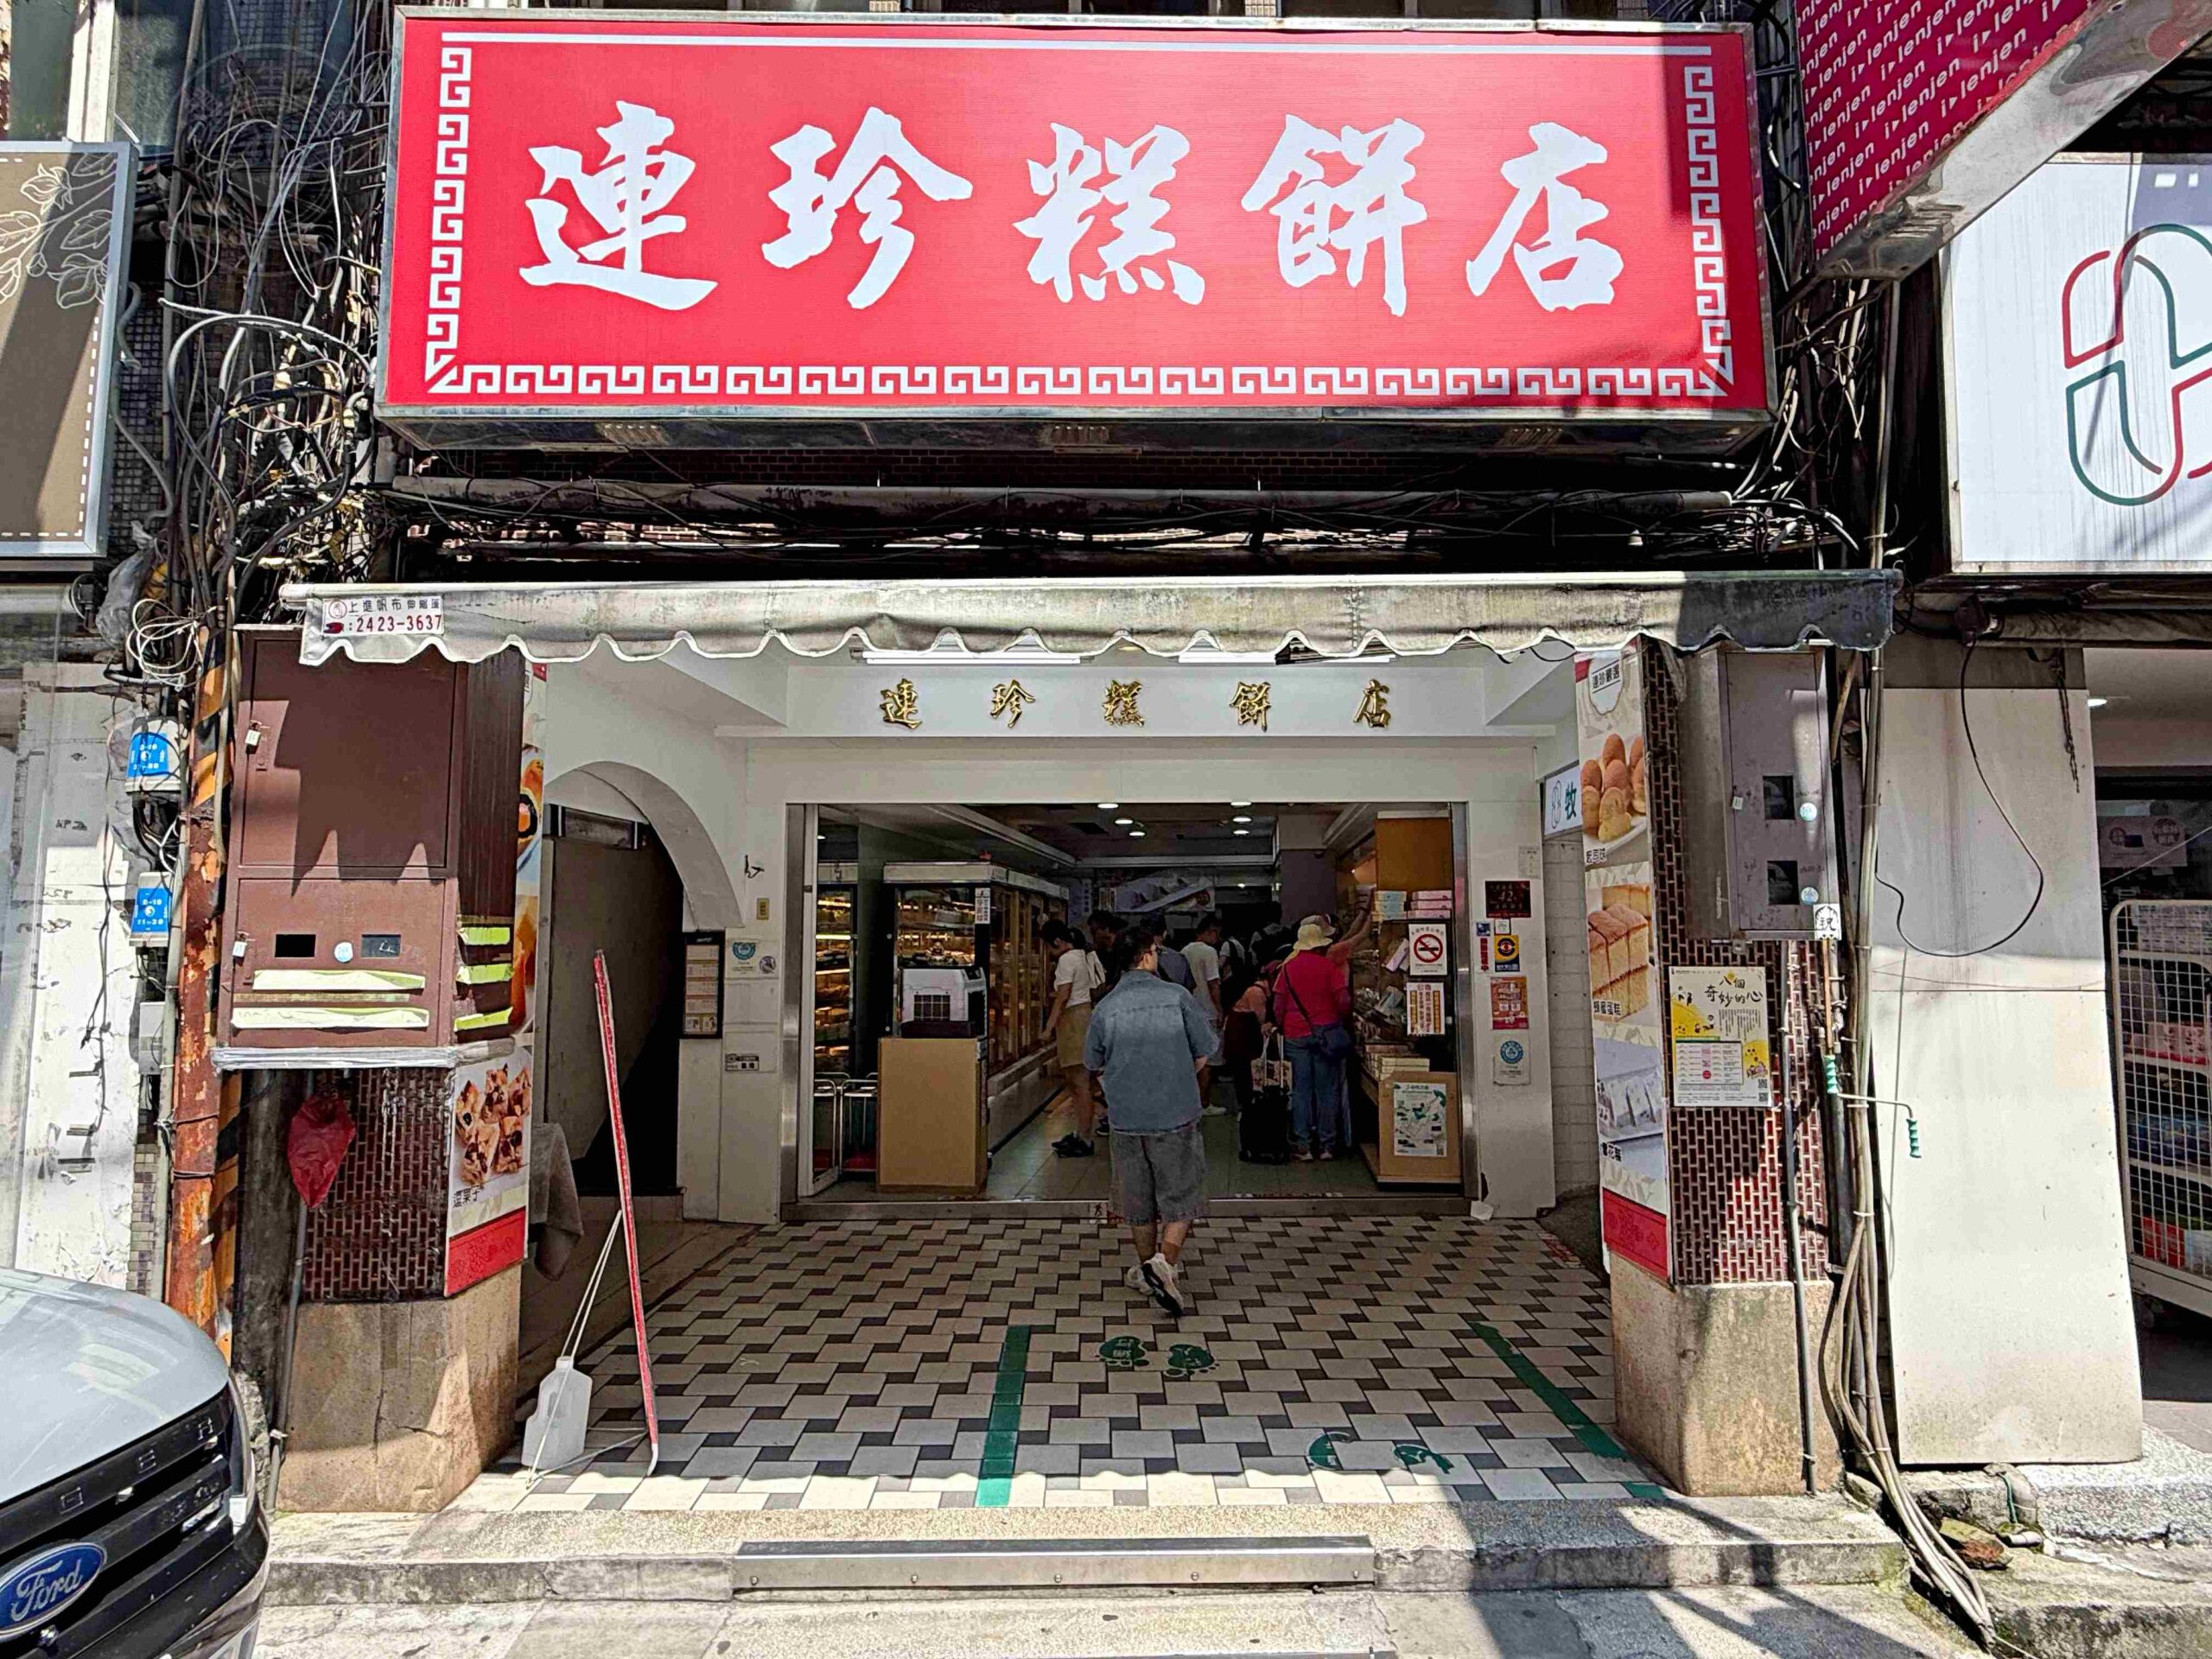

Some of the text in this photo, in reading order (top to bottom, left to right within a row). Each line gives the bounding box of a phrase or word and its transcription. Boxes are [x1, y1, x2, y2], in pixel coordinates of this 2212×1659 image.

[518, 100, 1624, 316] 連珍糕餅店
[880, 678, 1392, 733] 連珍糕餅店
[10, 1560, 83, 1624] Ford
